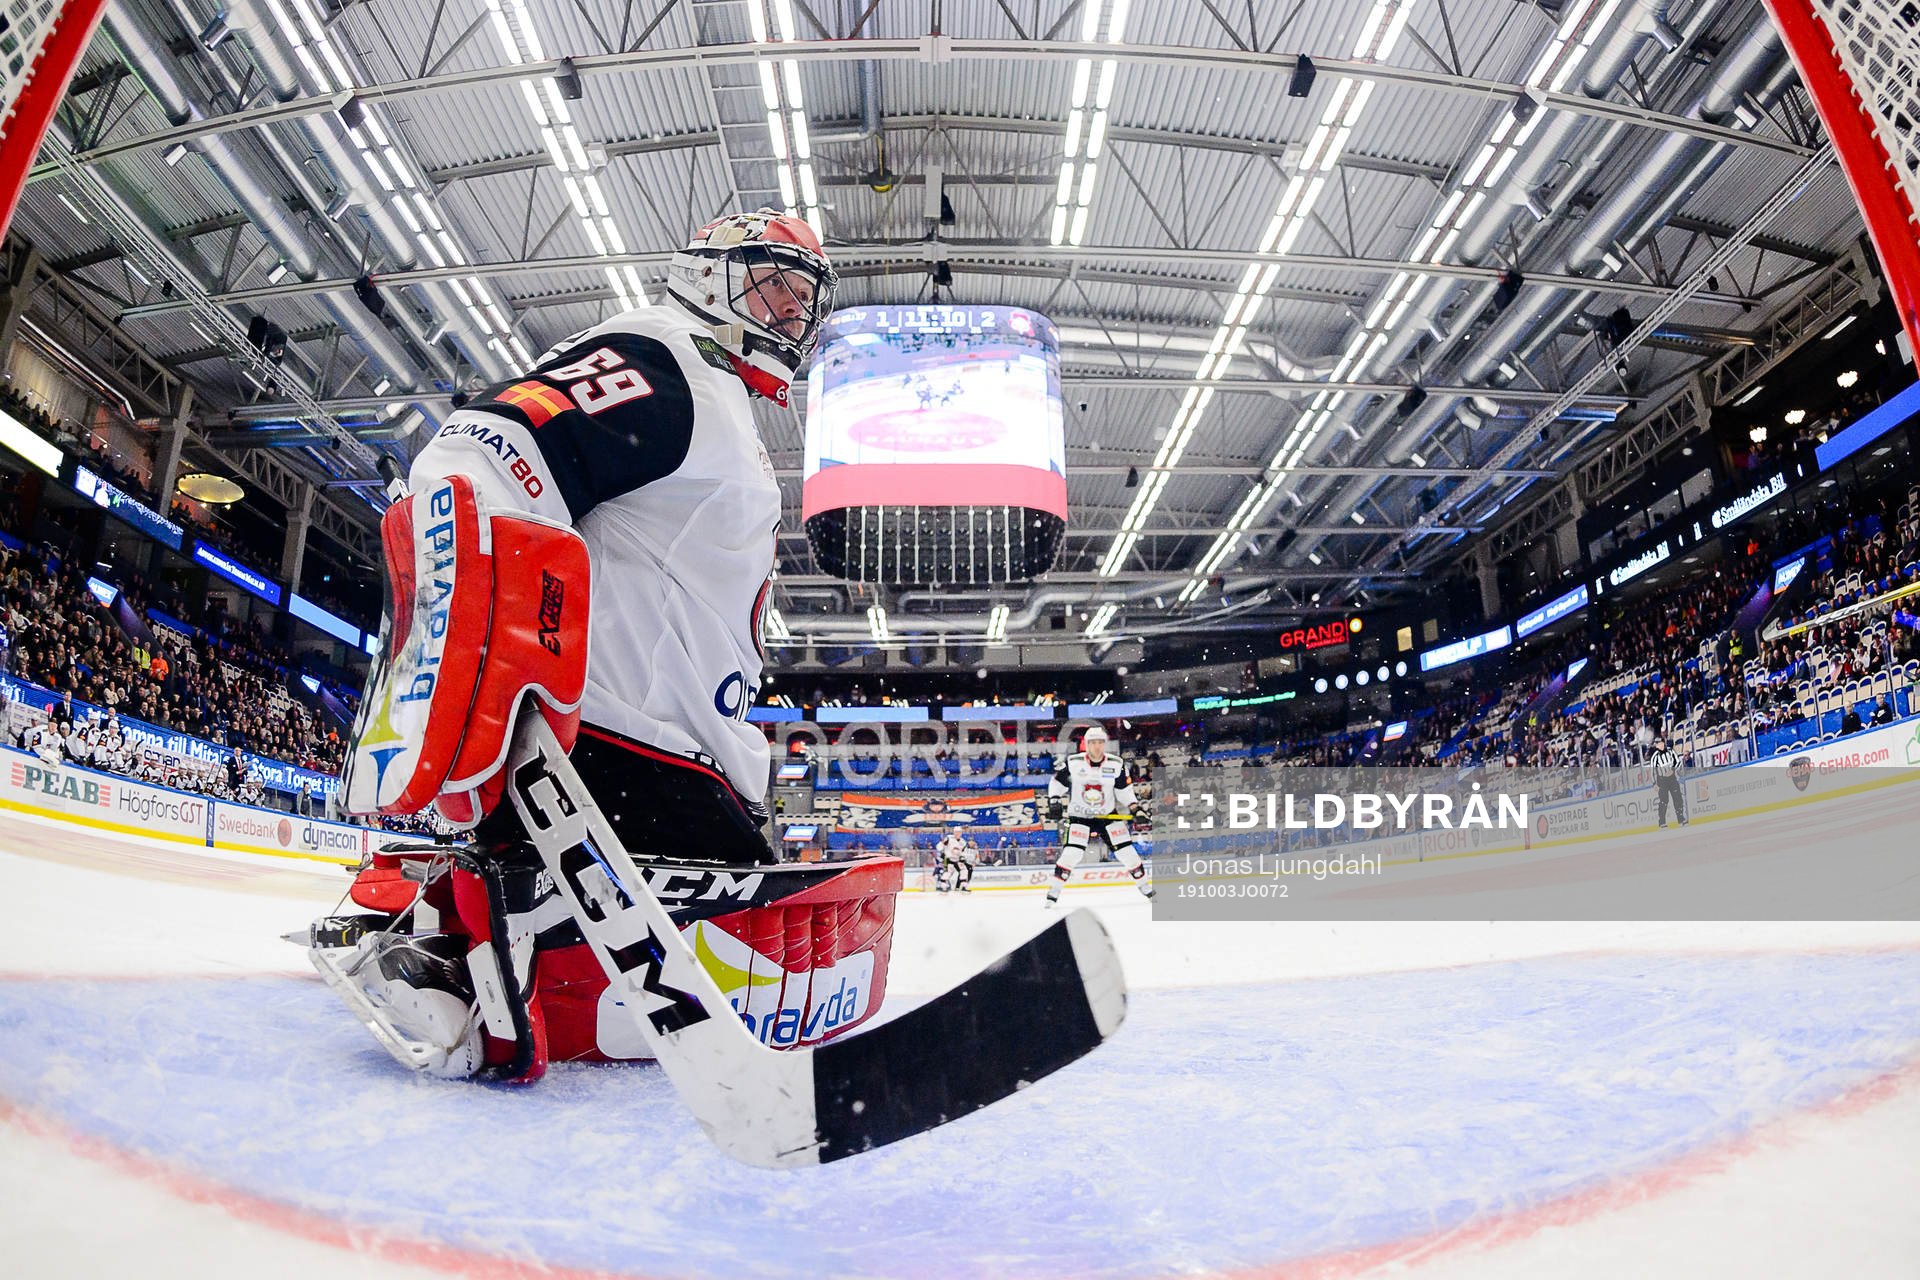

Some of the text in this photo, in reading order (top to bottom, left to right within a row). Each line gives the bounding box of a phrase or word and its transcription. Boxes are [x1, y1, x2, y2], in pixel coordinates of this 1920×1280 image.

[876, 311, 890, 327] 1
[980, 311, 996, 327] 2
[440, 423, 544, 499] CLIMAT80
[400, 485, 455, 703] bravida
[1280, 621, 1345, 649] GRAND
[1818, 748, 1890, 776] GEHAB.com
[22, 764, 101, 806] PEAB
[119, 786, 204, 825] HögforsGST
[218, 813, 276, 839] Swedbank
[302, 822, 358, 851] dynacon
[1424, 829, 1467, 852] RICOH
[514, 743, 712, 1036] CCM
[646, 867, 764, 901] CM
